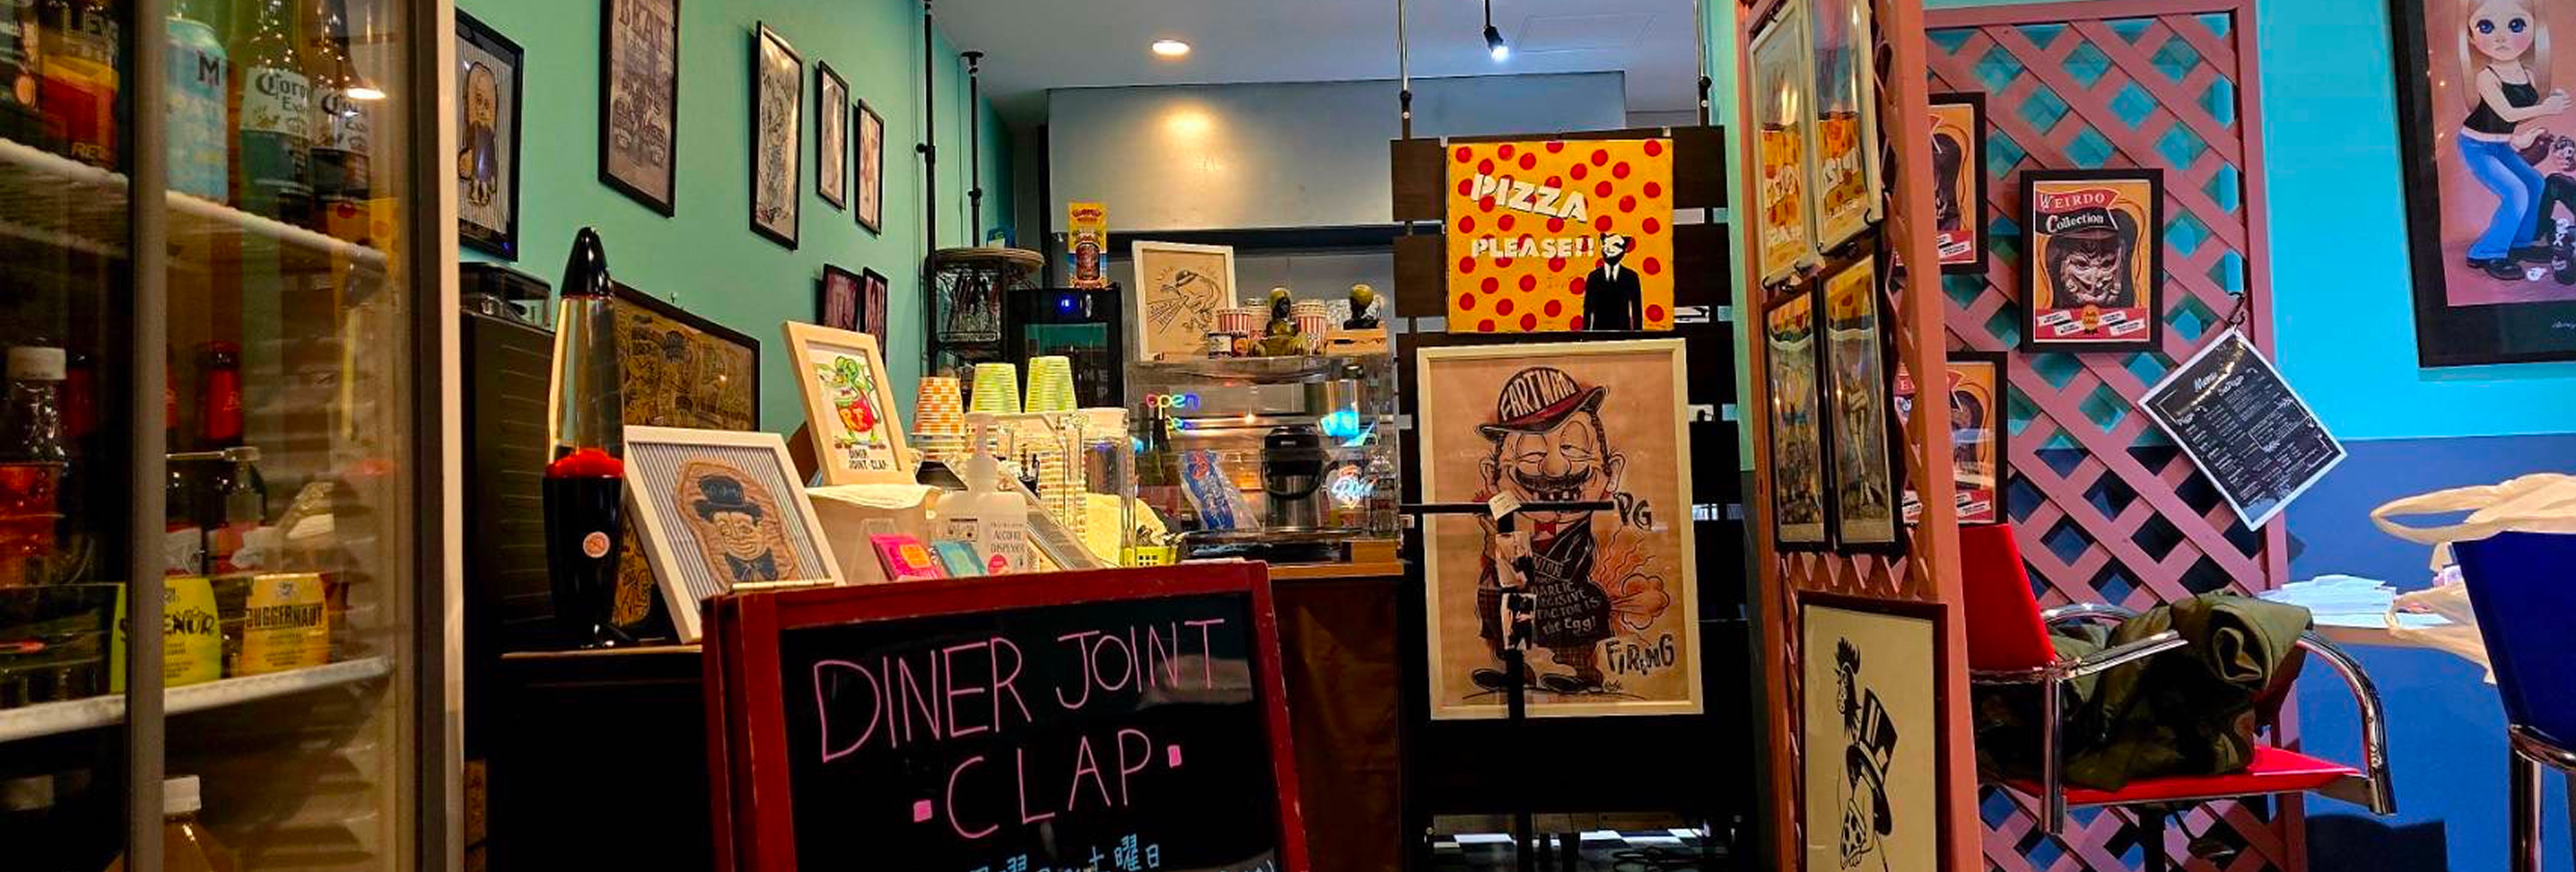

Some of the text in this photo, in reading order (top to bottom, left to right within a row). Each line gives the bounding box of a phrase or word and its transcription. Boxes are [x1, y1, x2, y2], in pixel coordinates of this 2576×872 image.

[1470, 172, 1588, 224] PIZZA
[2039, 192, 2105, 212] WEIRDO
[2046, 212, 2104, 233] Collection
[1471, 237, 1595, 258] PLEASE!!
[1500, 369, 1578, 422] FARTMAN
[1614, 492, 1652, 532] PG
[814, 618, 1225, 763] DINER JOINT
